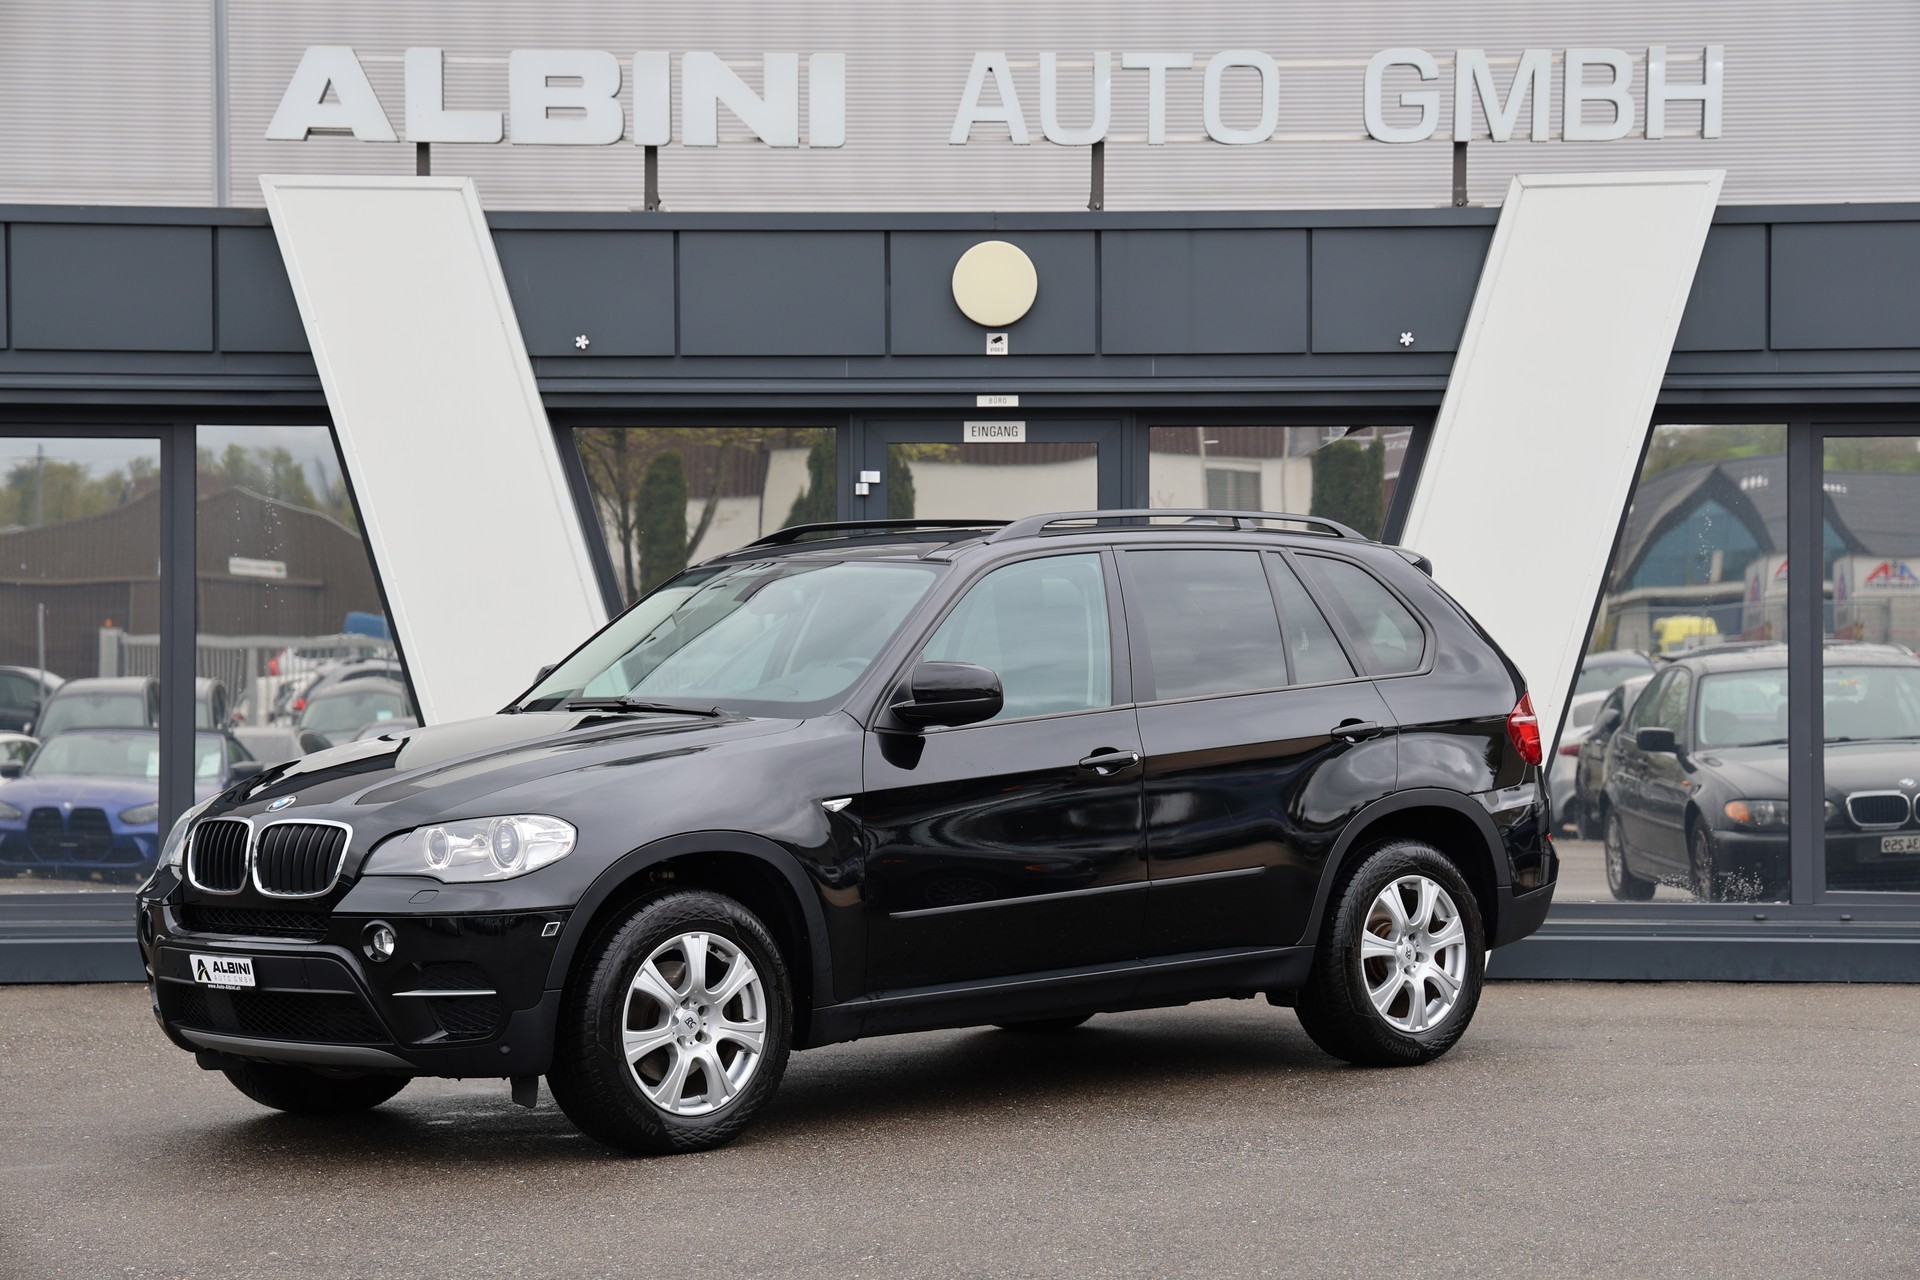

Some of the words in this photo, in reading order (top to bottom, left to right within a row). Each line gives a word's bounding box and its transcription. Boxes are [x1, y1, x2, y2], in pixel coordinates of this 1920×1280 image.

[265, 45, 847, 149] ALBINI
[949, 49, 1281, 147] AUTO
[1362, 44, 1725, 144] GMBH
[971, 425, 1019, 438] EINGANG
[213, 960, 251, 975] ALBINI
